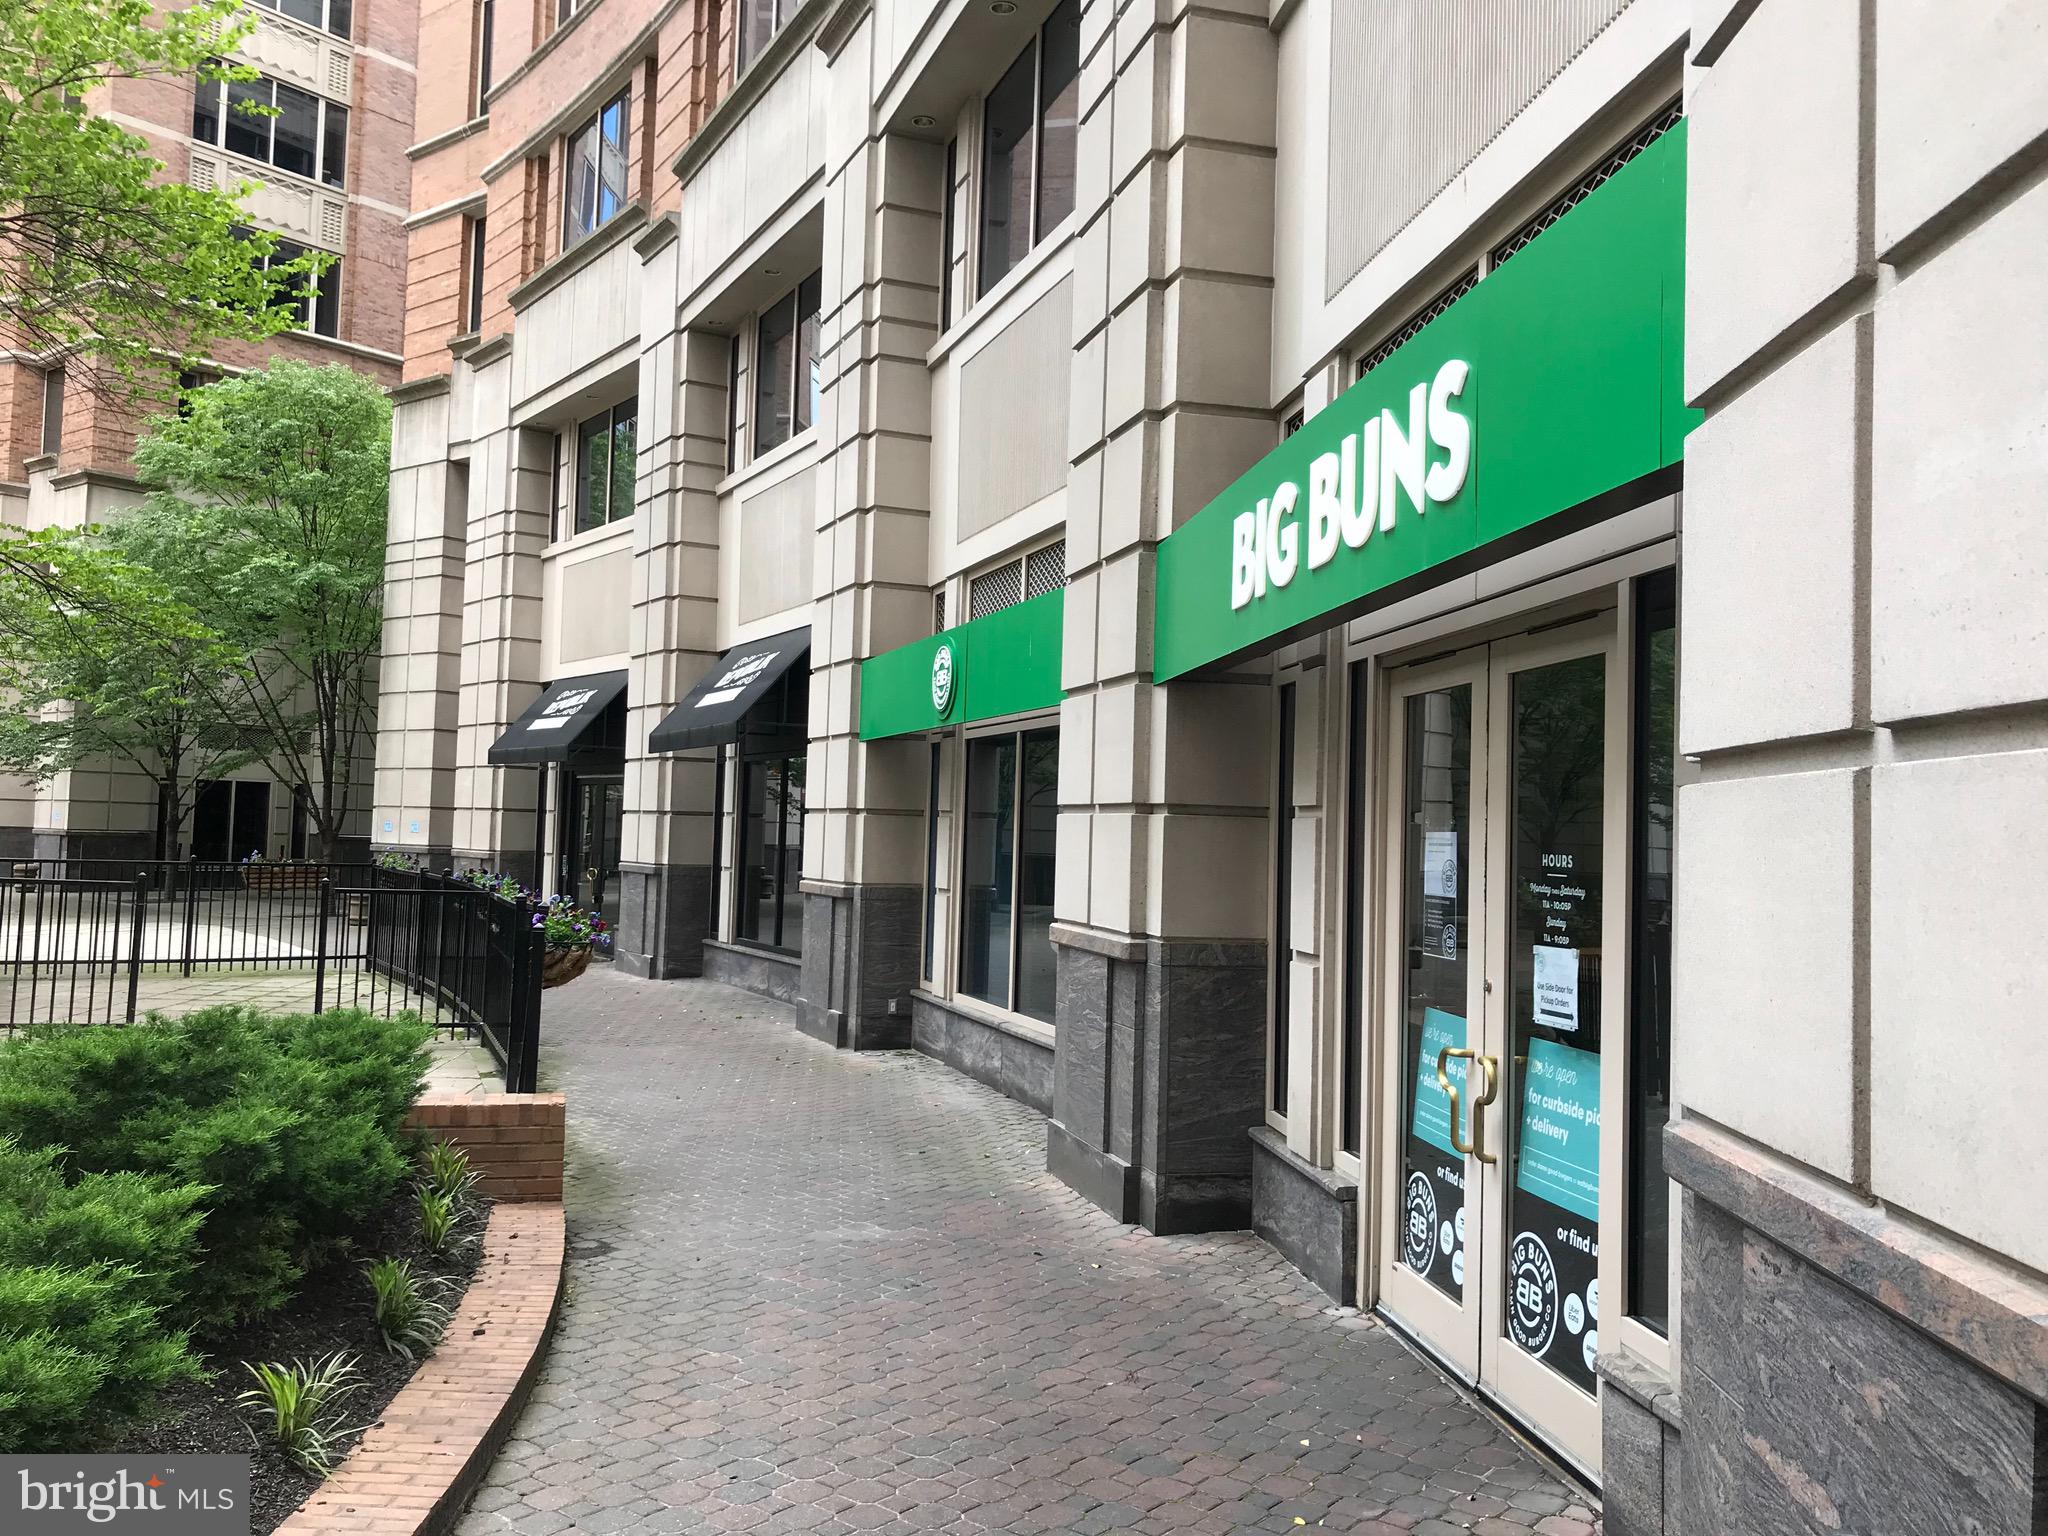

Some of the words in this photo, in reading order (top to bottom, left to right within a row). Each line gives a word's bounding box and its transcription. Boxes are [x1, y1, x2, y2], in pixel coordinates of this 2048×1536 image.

[1231, 481, 1299, 610] BIG
[1307, 359, 1471, 570] BUNS
[1542, 853, 1573, 868] HOURS
[1421, 1048, 1431, 1065] for
[1555, 1067, 1578, 1088] open
[1528, 1086, 1542, 1105] for
[1542, 1096, 1584, 1120] curbside
[1531, 1114, 1569, 1145] delivery
[1437, 1166, 1444, 1179] or
[1445, 1166, 1458, 1187] find
[1556, 1227, 1568, 1242] or
[1569, 1228, 1590, 1254] find
[1512, 1244, 1526, 1276] BIG
[1528, 1242, 1553, 1294] BUNS
[1513, 1318, 1527, 1343] GOOD
[1528, 1323, 1548, 1346] BURGER
